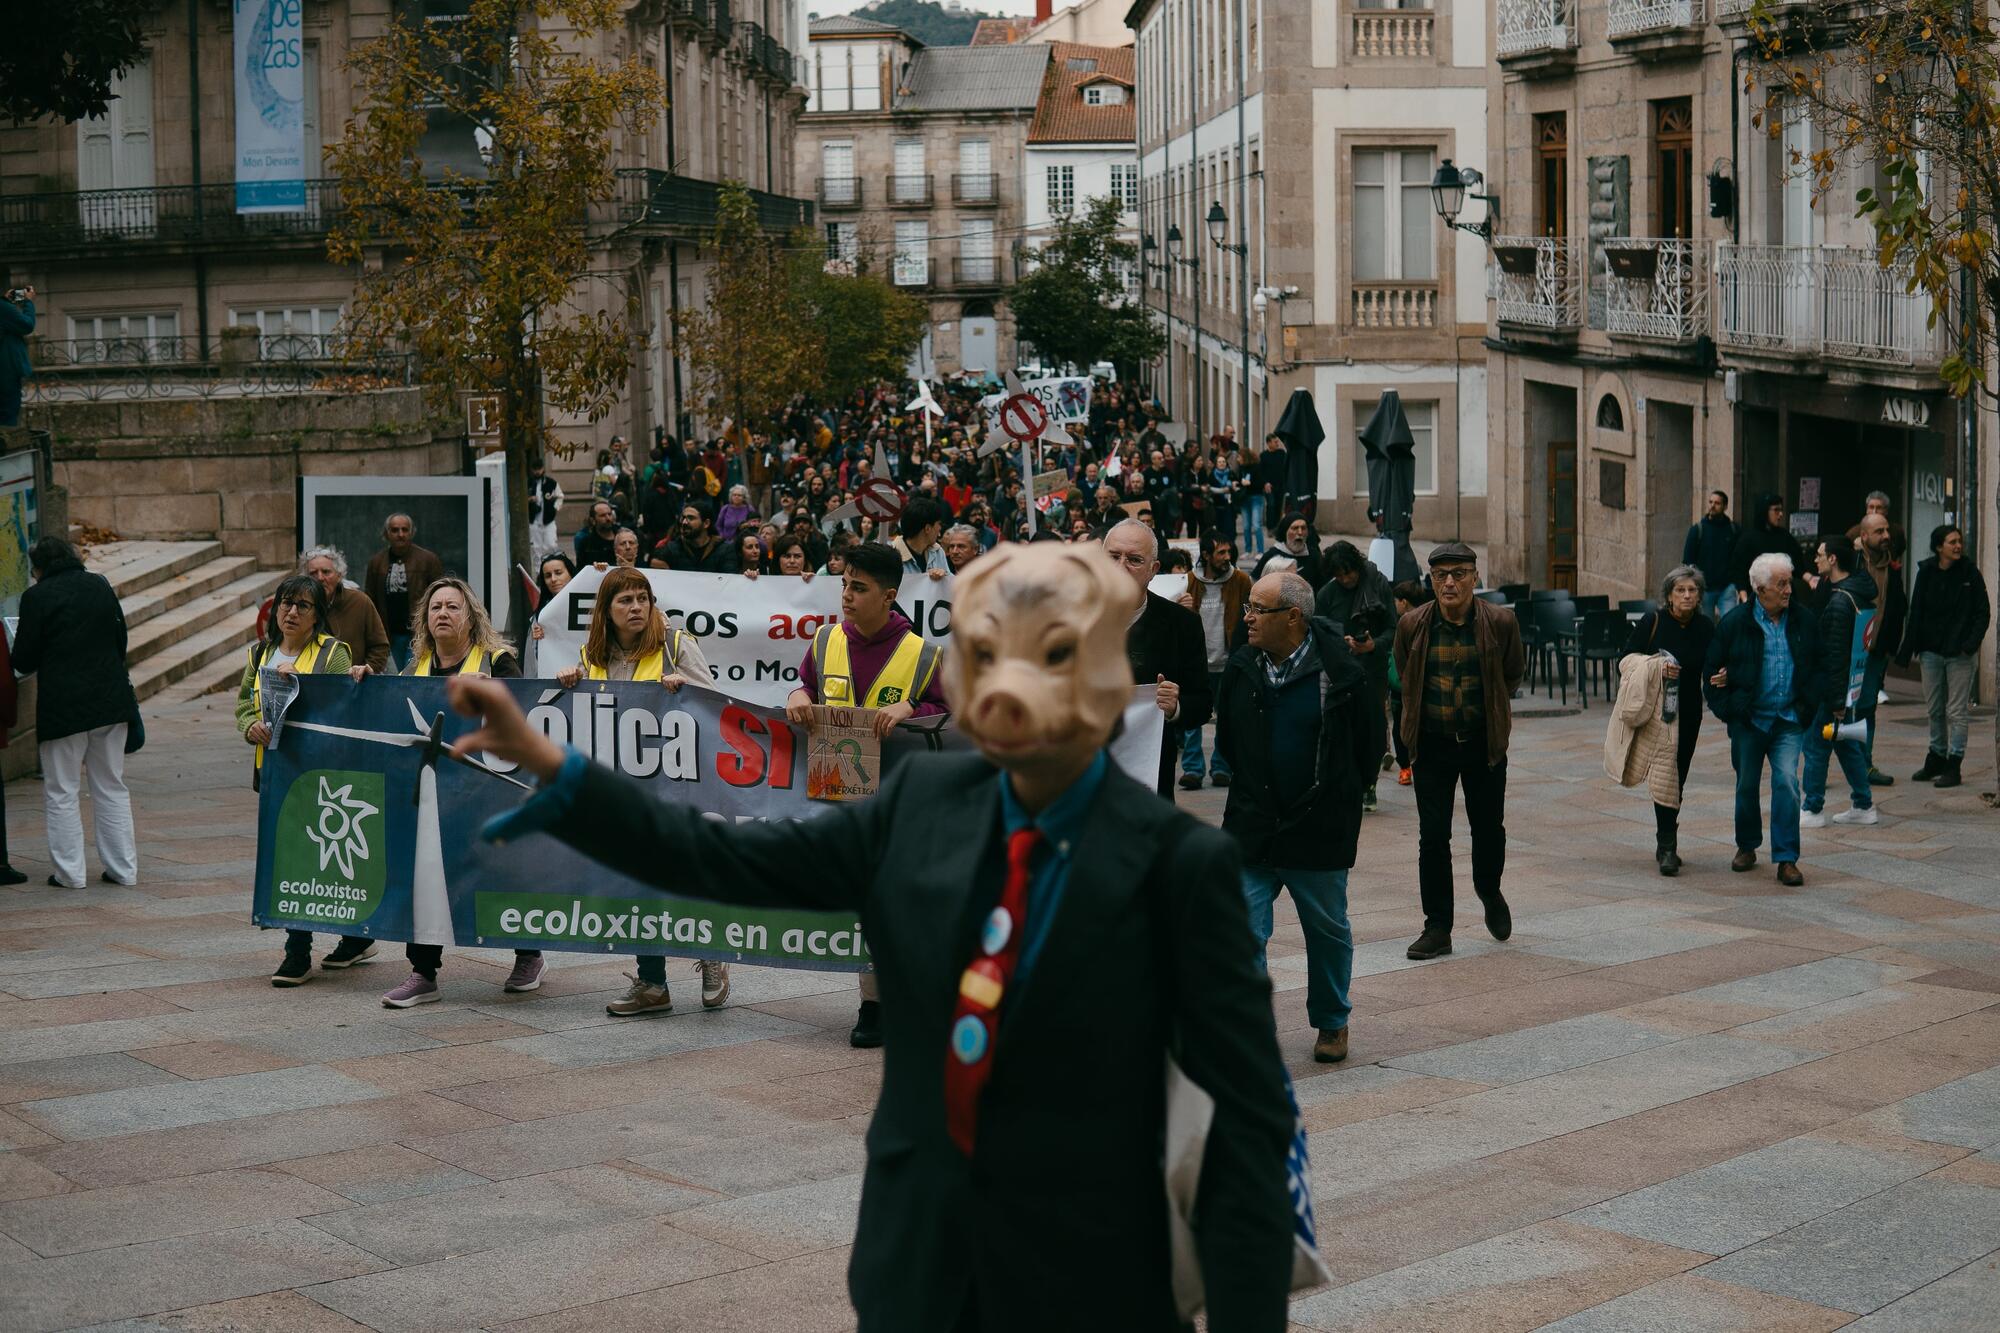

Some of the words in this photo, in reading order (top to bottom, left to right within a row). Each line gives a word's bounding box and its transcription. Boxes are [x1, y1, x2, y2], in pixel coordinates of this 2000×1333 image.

[262, 39, 299, 68] zas
[728, 665, 745, 681] o
[830, 708, 853, 728] NON
[279, 878, 367, 902] ecoloxistas
[278, 899, 300, 914] en
[305, 901, 357, 920] acción
[500, 900, 713, 944] ecoloxistas
[725, 922, 768, 950] en
